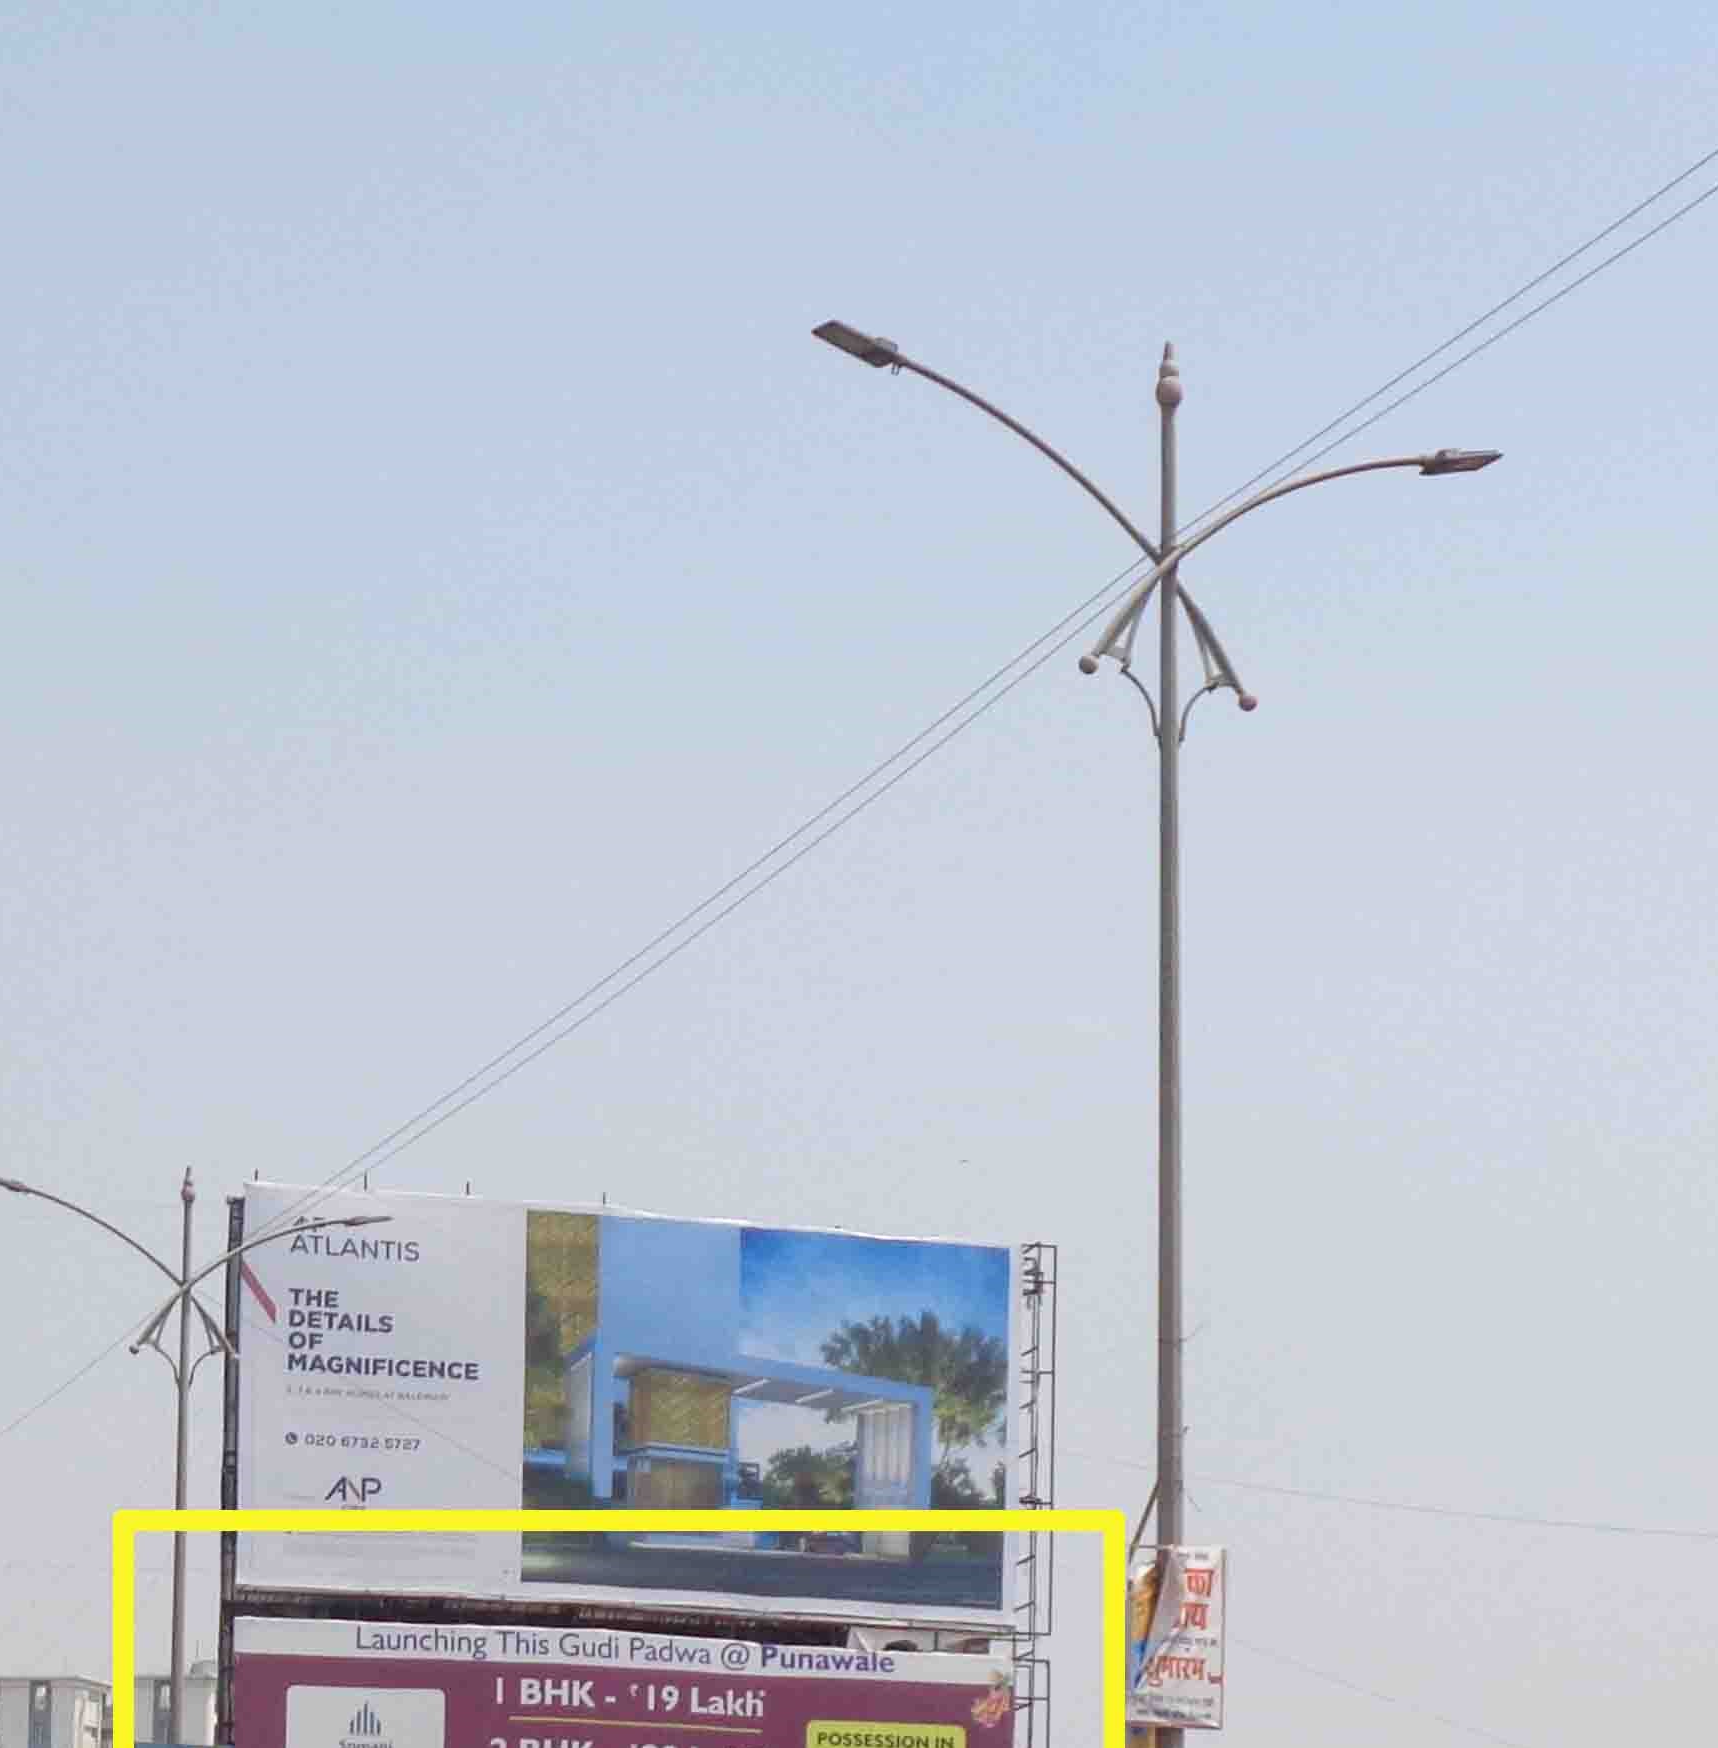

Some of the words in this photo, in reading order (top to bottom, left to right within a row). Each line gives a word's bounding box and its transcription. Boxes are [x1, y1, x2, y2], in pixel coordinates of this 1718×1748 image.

[290, 1234, 420, 1262] ATLANTIS
[288, 1288, 340, 1308] THE
[288, 1310, 394, 1333] DETAILS
[288, 1332, 324, 1350] OF
[287, 1353, 480, 1380] MAGNIFICENCE
[305, 1433, 334, 1447] 020
[356, 1626, 487, 1660] Launching
[498, 1631, 550, 1656] This
[558, 1633, 620, 1660] Gudi
[629, 1637, 710, 1666] Padwa
[720, 1642, 750, 1672] @
[761, 1645, 896, 1674] Punawale
[519, 1678, 596, 1707] BHK
